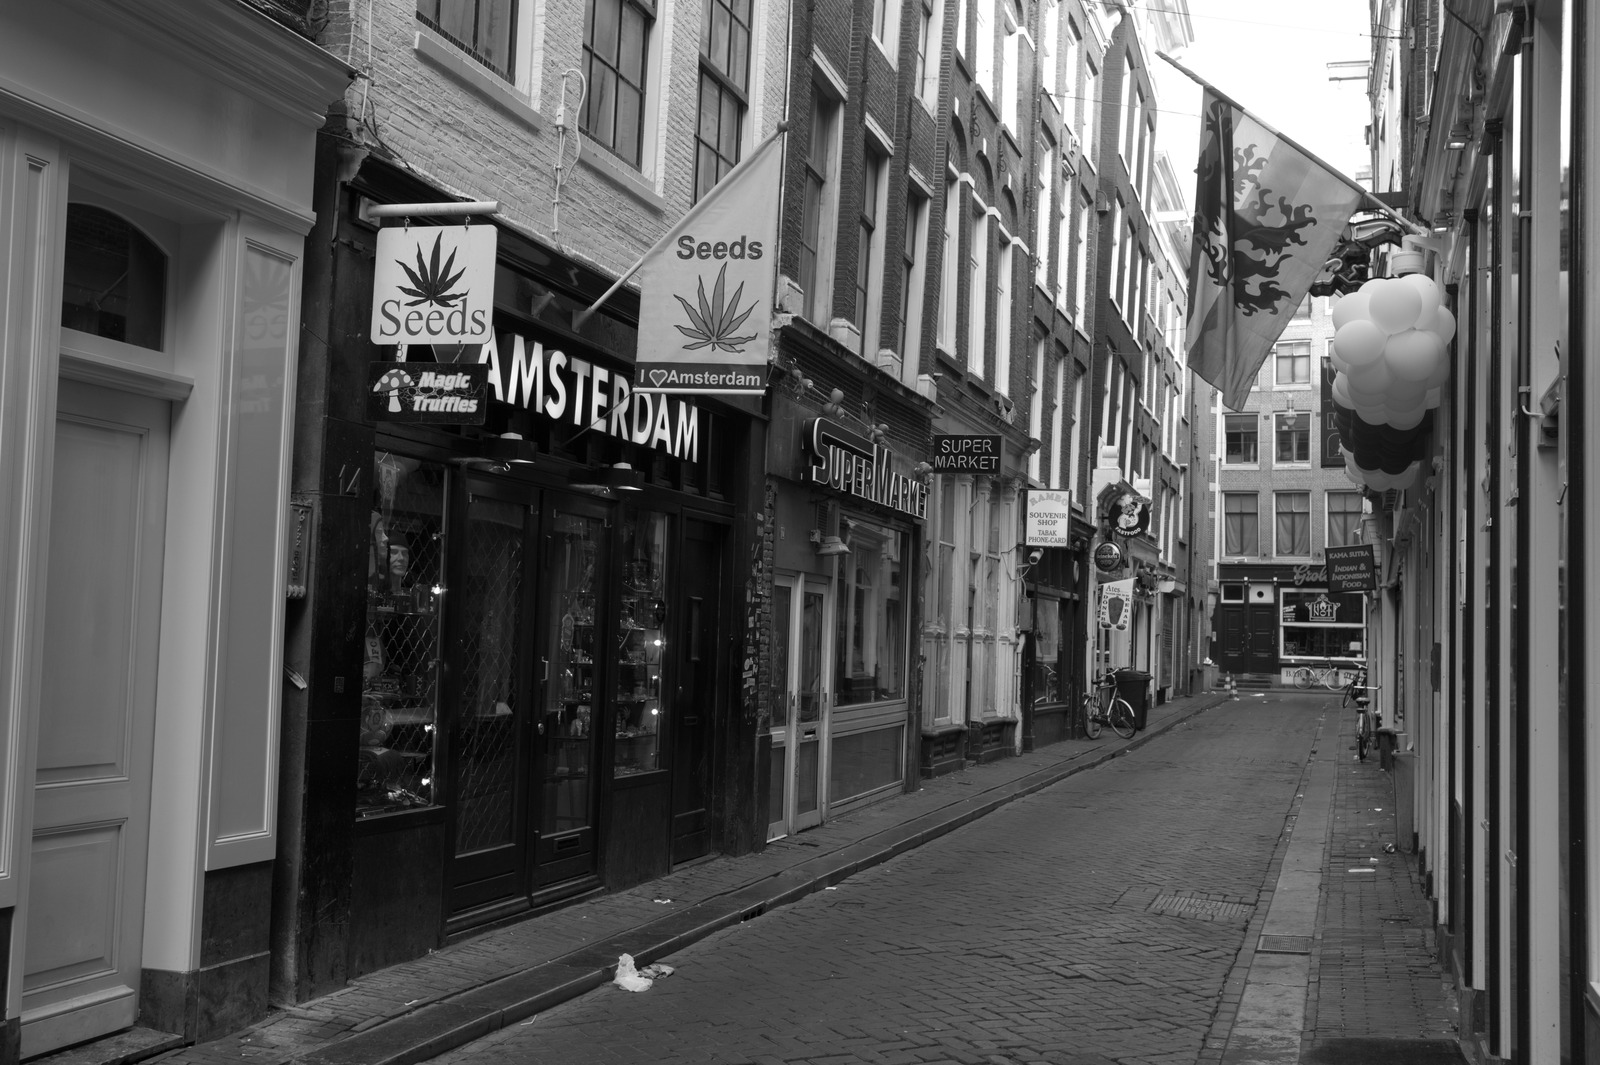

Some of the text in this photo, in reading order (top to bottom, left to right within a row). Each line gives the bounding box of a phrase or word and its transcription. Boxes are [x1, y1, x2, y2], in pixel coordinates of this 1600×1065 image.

[676, 235, 763, 260] Seeds
[379, 298, 487, 338] Seeds
[418, 371, 471, 391] Magic
[667, 369, 761, 387] Amsterdam
[477, 324, 699, 464] AMSTERDAM
[413, 395, 478, 413] Truffles
[941, 439, 992, 453] SUPER
[934, 455, 999, 469] MARKET
[338, 464, 361, 498] 14
[1029, 492, 1069, 506] RAMBO
[1115, 527, 1142, 535] FASTFOOD
[1028, 536, 1067, 544] PHONE-CARD
[1334, 563, 1367, 573] INDIAN &
[1332, 572, 1371, 581] INDONESIAN
[1342, 580, 1362, 589] FOOD
[1123, 597, 1131, 625] KEBAB
[1285, 670, 1303, 678] BAR
